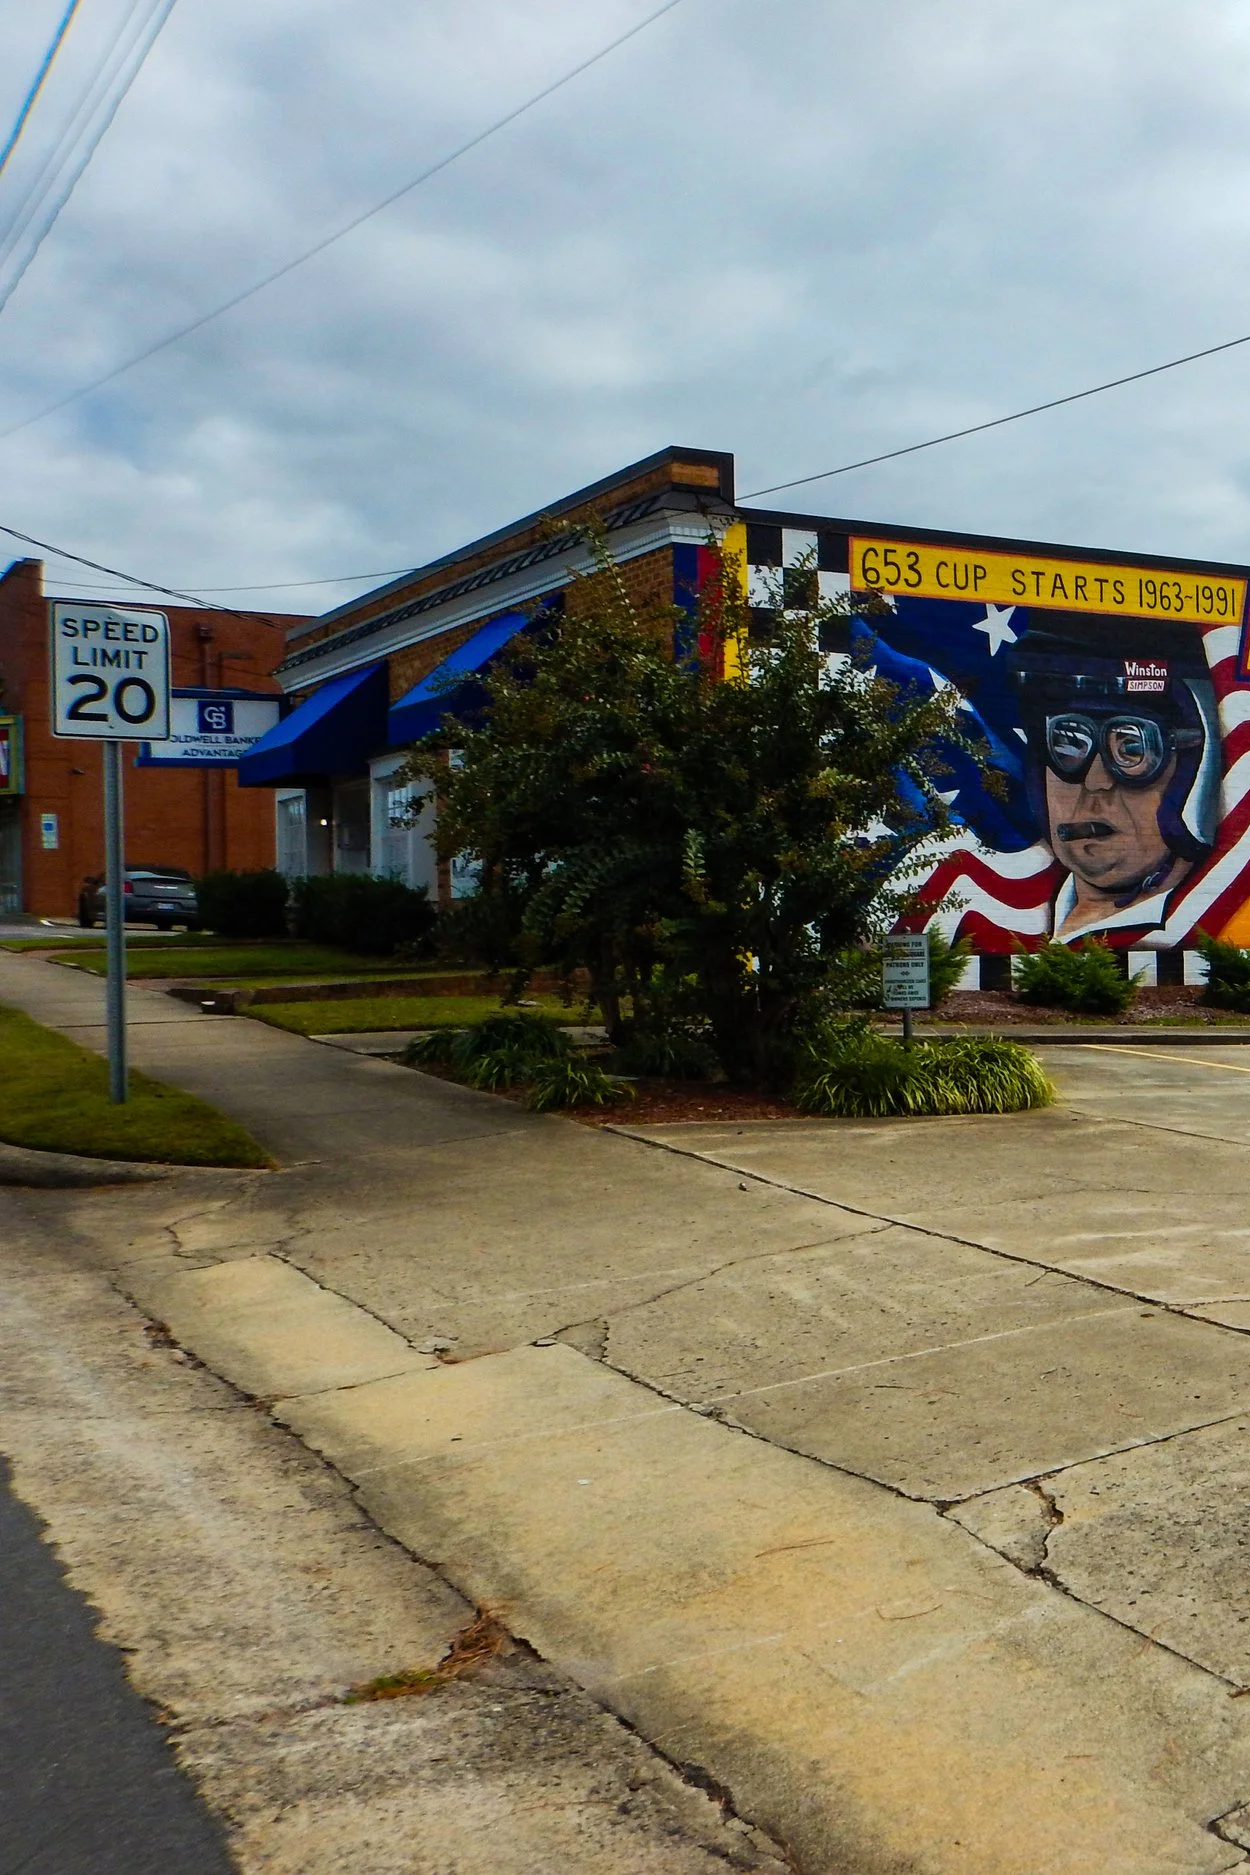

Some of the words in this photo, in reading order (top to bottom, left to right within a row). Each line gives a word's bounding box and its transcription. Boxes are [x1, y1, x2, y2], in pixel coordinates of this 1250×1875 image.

[862, 547, 922, 588] 653
[936, 561, 987, 592] CUP
[1012, 569, 1125, 605] STARTS
[62, 617, 159, 643] SPEED
[72, 646, 148, 670] LIMIT
[1124, 661, 1168, 677] Winston
[1129, 681, 1164, 690] SIMPSON
[66, 673, 156, 724] 20
[170, 734, 222, 745] OLDWELL
[182, 748, 248, 758] ADVANTAG
